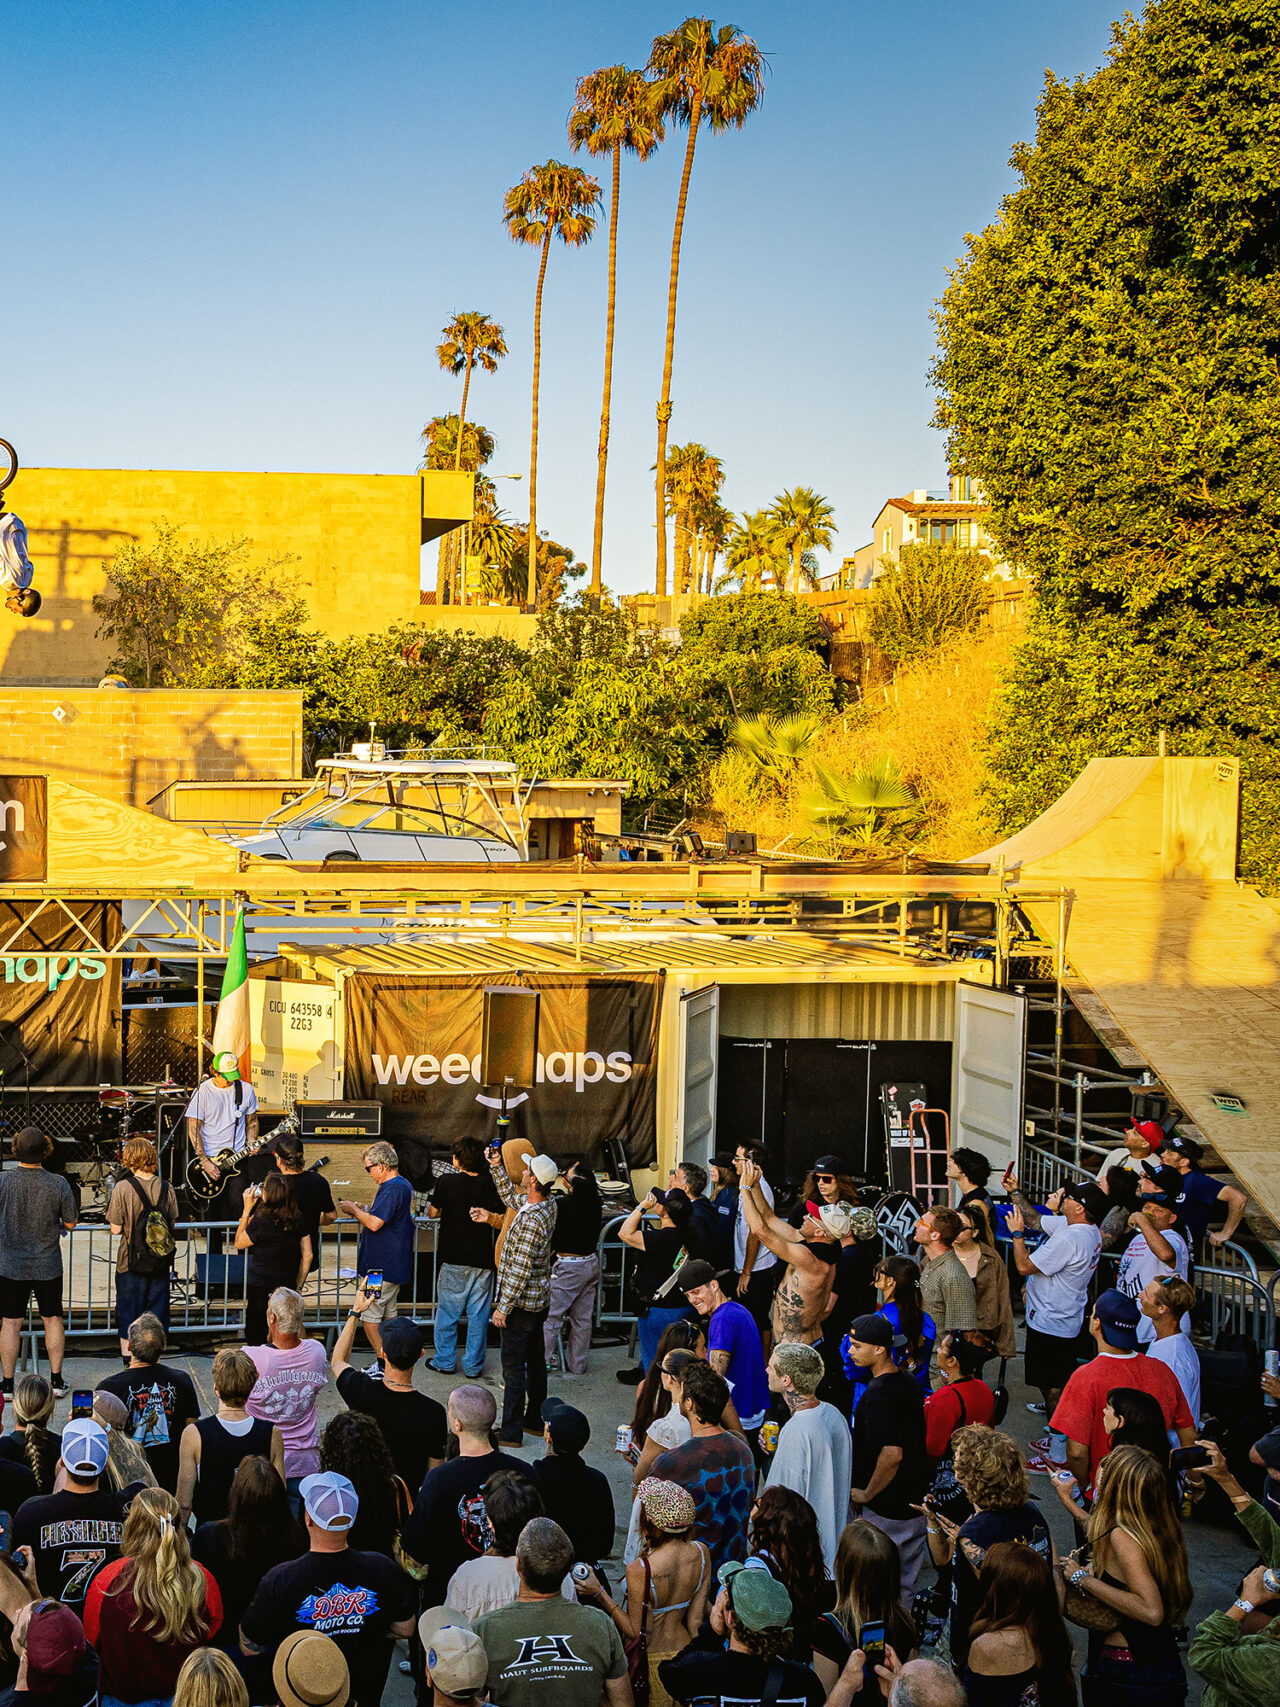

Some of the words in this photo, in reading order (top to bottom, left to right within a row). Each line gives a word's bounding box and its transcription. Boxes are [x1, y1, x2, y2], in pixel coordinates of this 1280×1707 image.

[1218, 765, 1233, 776] wm
[269, 1000, 287, 1014] CICU
[290, 1002, 323, 1018] 643558
[326, 1006, 333, 1018] 4
[290, 1017, 313, 1031] 22G3
[372, 1051, 632, 1093] weeaps
[326, 1110, 356, 1119] Marshall
[40, 1520, 125, 1549] PLESSINGER
[60, 1548, 106, 1602] 7
[312, 1591, 367, 1620] DBK
[314, 1616, 345, 1630] MOTO
[346, 1614, 364, 1625] CO.
[504, 1634, 589, 1670] H
[499, 1669, 528, 1680] HAUT
[530, 1664, 594, 1674] SURFBOARDS
